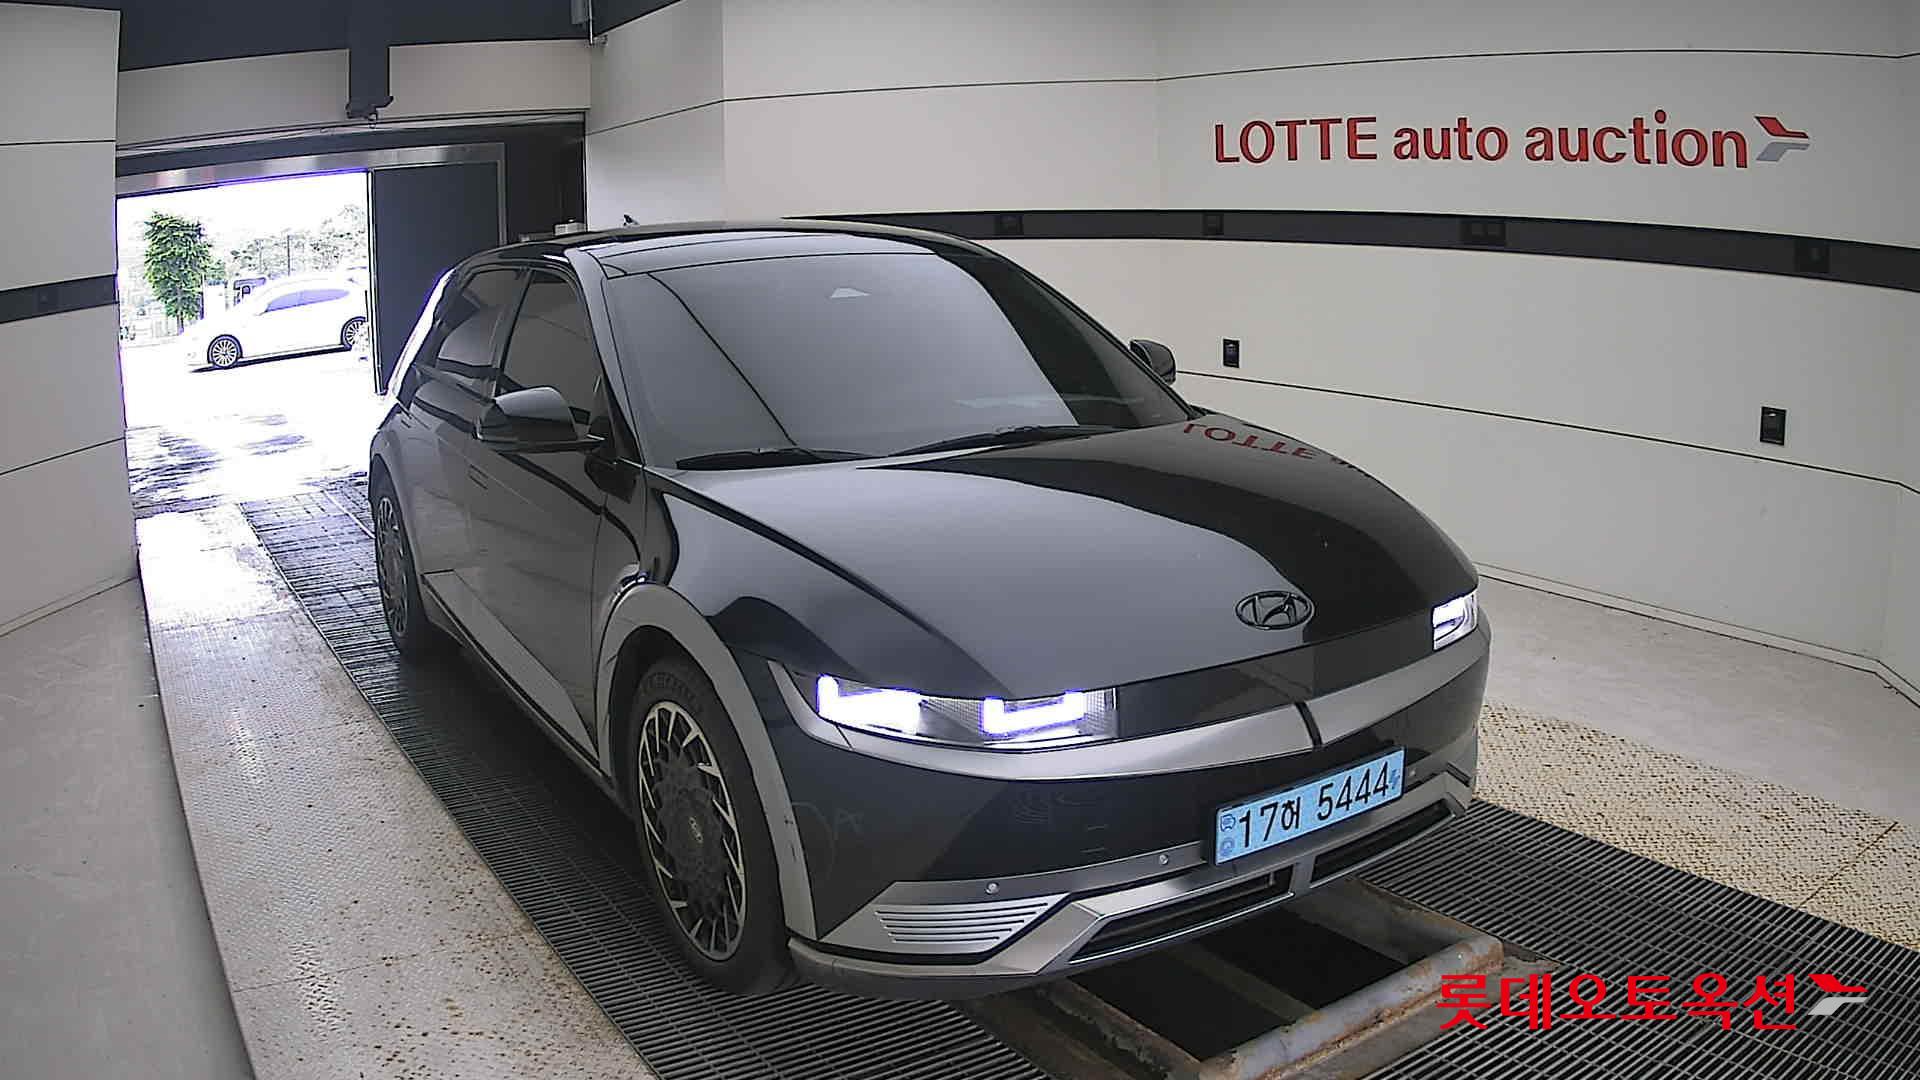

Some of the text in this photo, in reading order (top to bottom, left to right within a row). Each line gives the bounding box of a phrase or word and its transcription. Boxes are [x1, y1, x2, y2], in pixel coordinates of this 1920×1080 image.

[1214, 109, 1749, 169] LOTTE auto auction
[1238, 761, 1390, 848] 17허 5444
